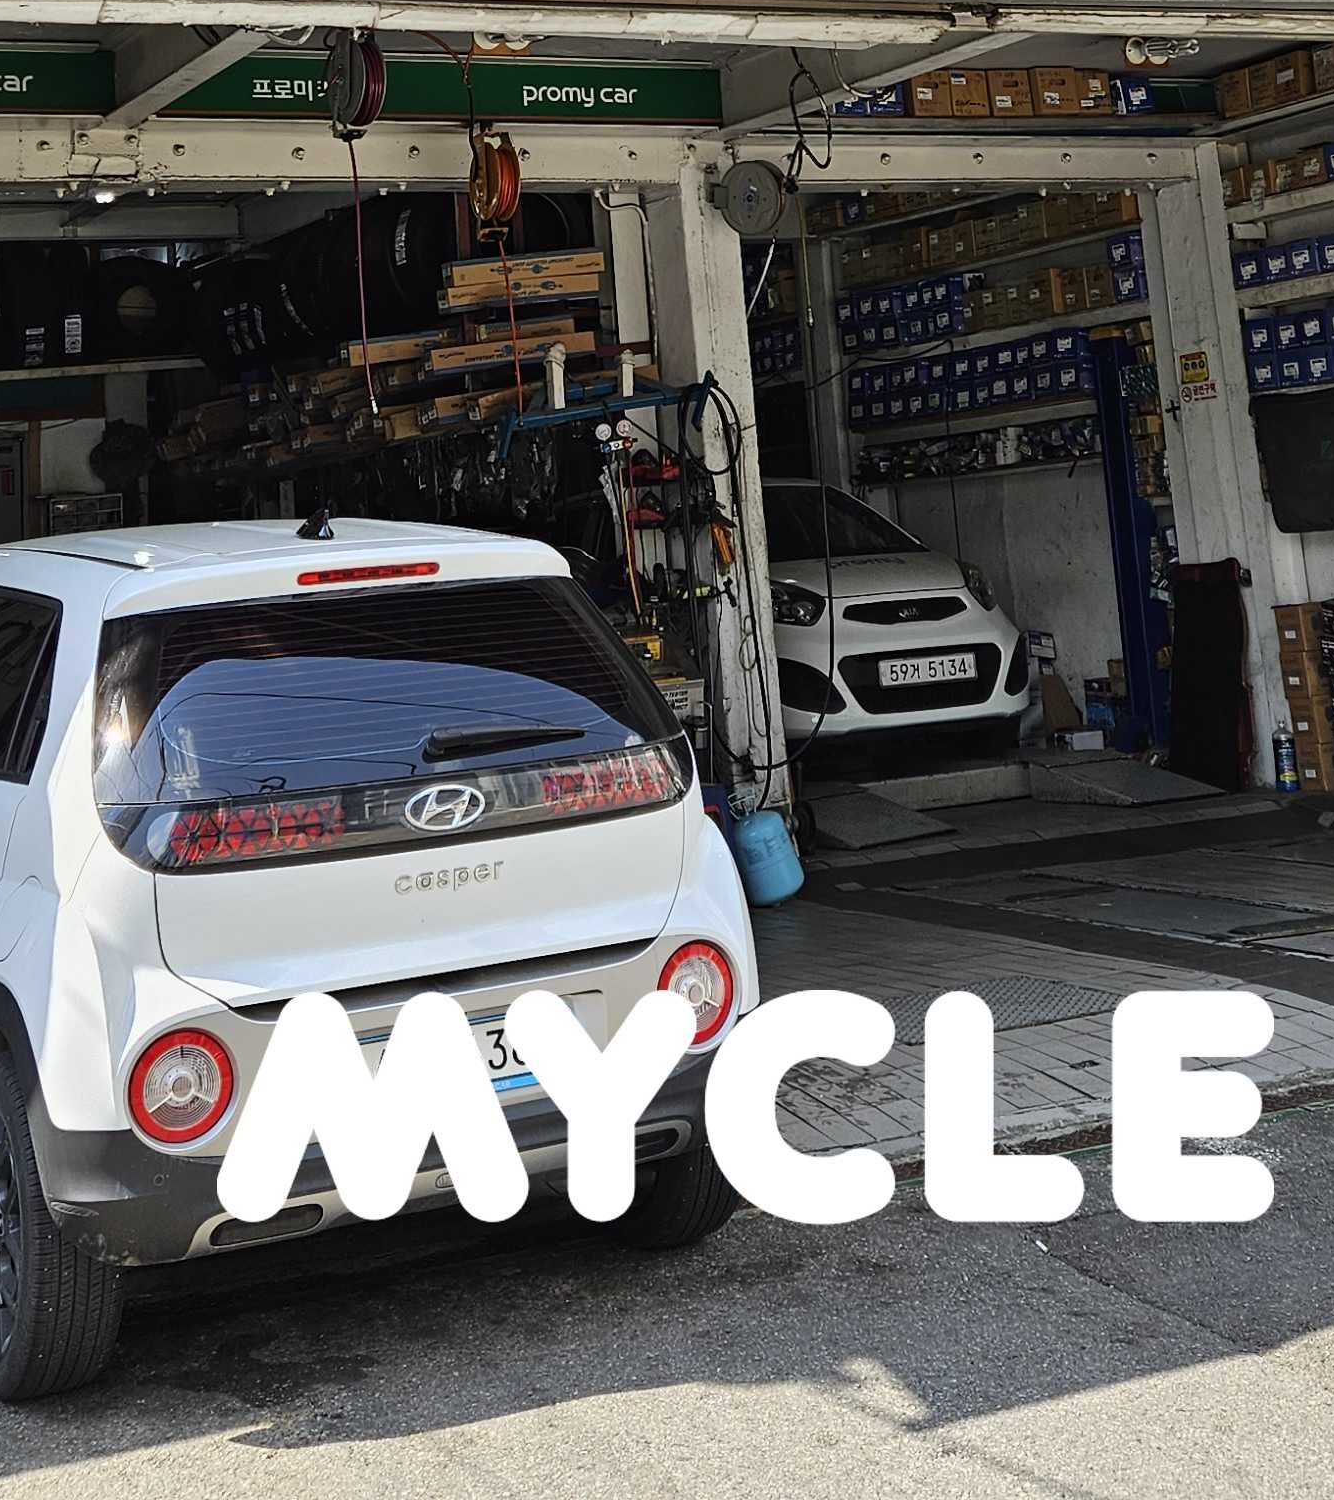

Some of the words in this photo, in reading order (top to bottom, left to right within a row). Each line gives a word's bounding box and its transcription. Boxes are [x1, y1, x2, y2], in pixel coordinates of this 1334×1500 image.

[522, 83, 595, 108] promy
[599, 84, 638, 105] car
[928, 657, 968, 679] 5134
[394, 858, 505, 897] casper
